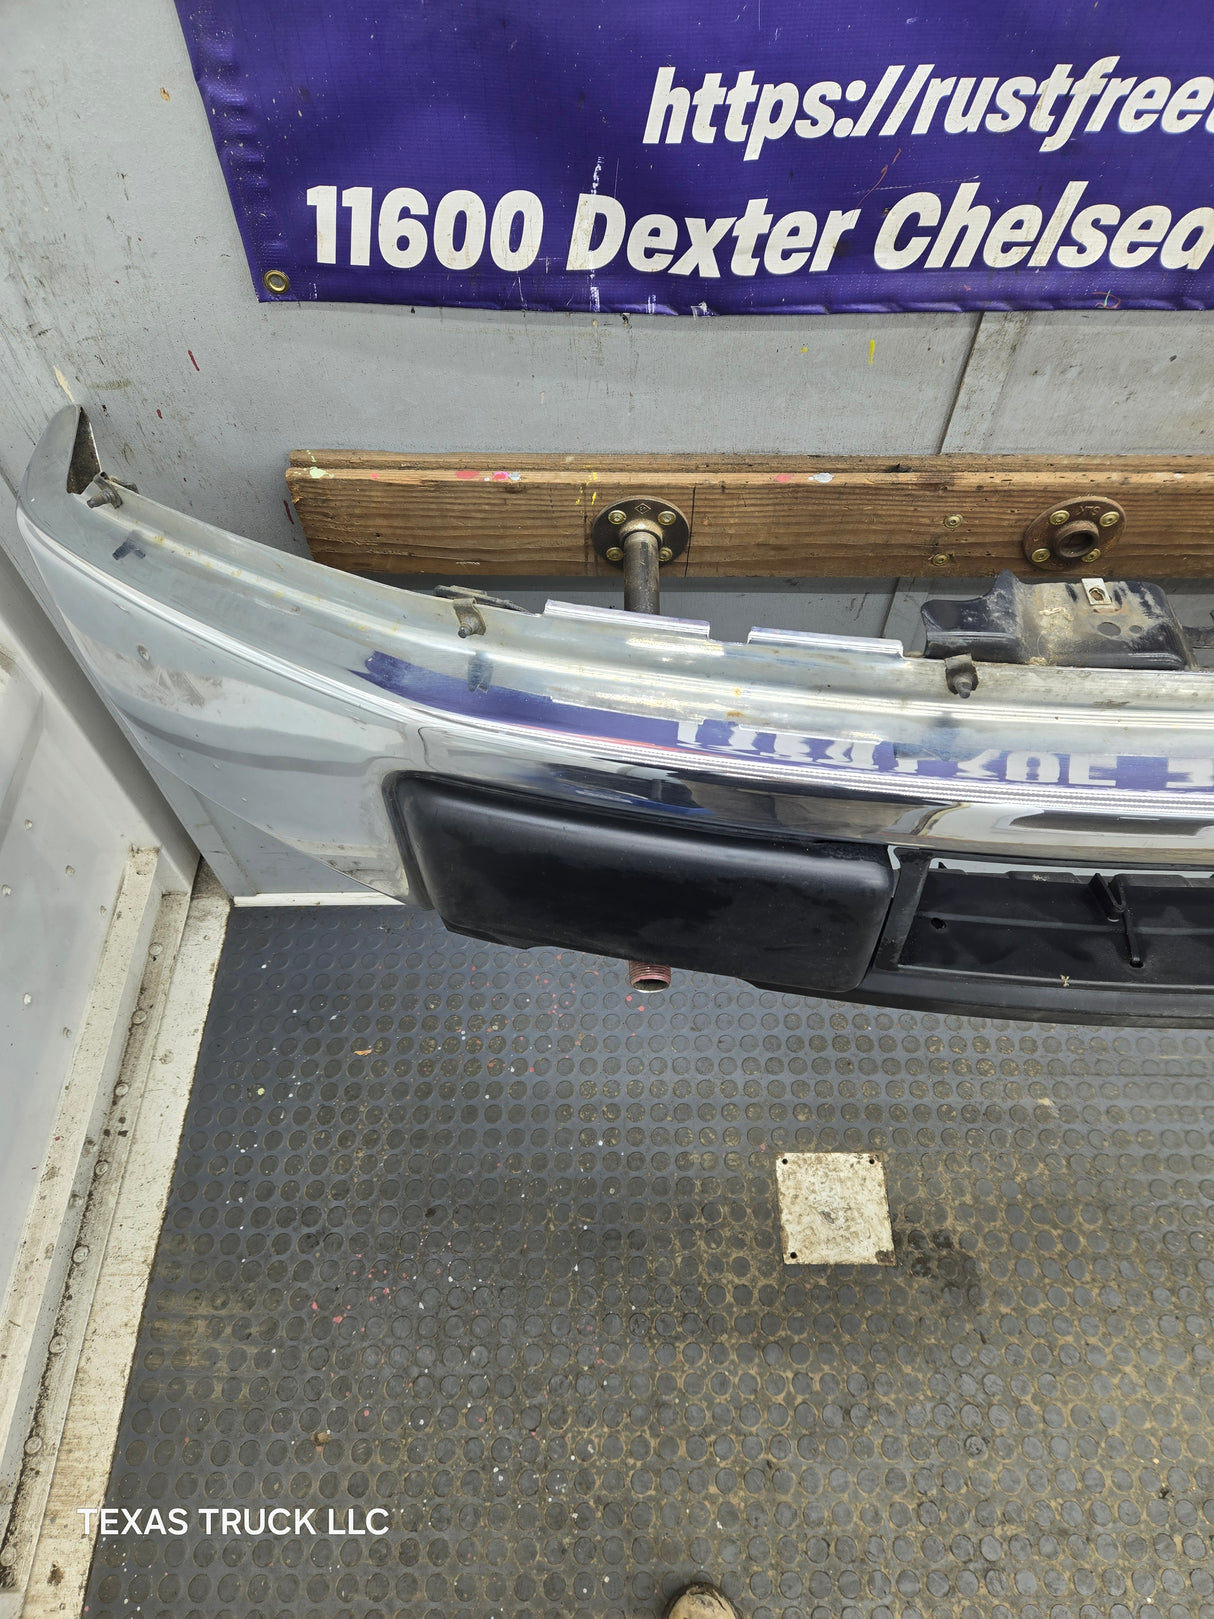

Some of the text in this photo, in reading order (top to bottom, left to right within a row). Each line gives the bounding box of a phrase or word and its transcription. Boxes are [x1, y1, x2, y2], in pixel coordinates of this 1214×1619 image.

[642, 55, 1214, 161] https://rustfree
[306, 180, 1214, 278] 11600 Dexter Chelsea
